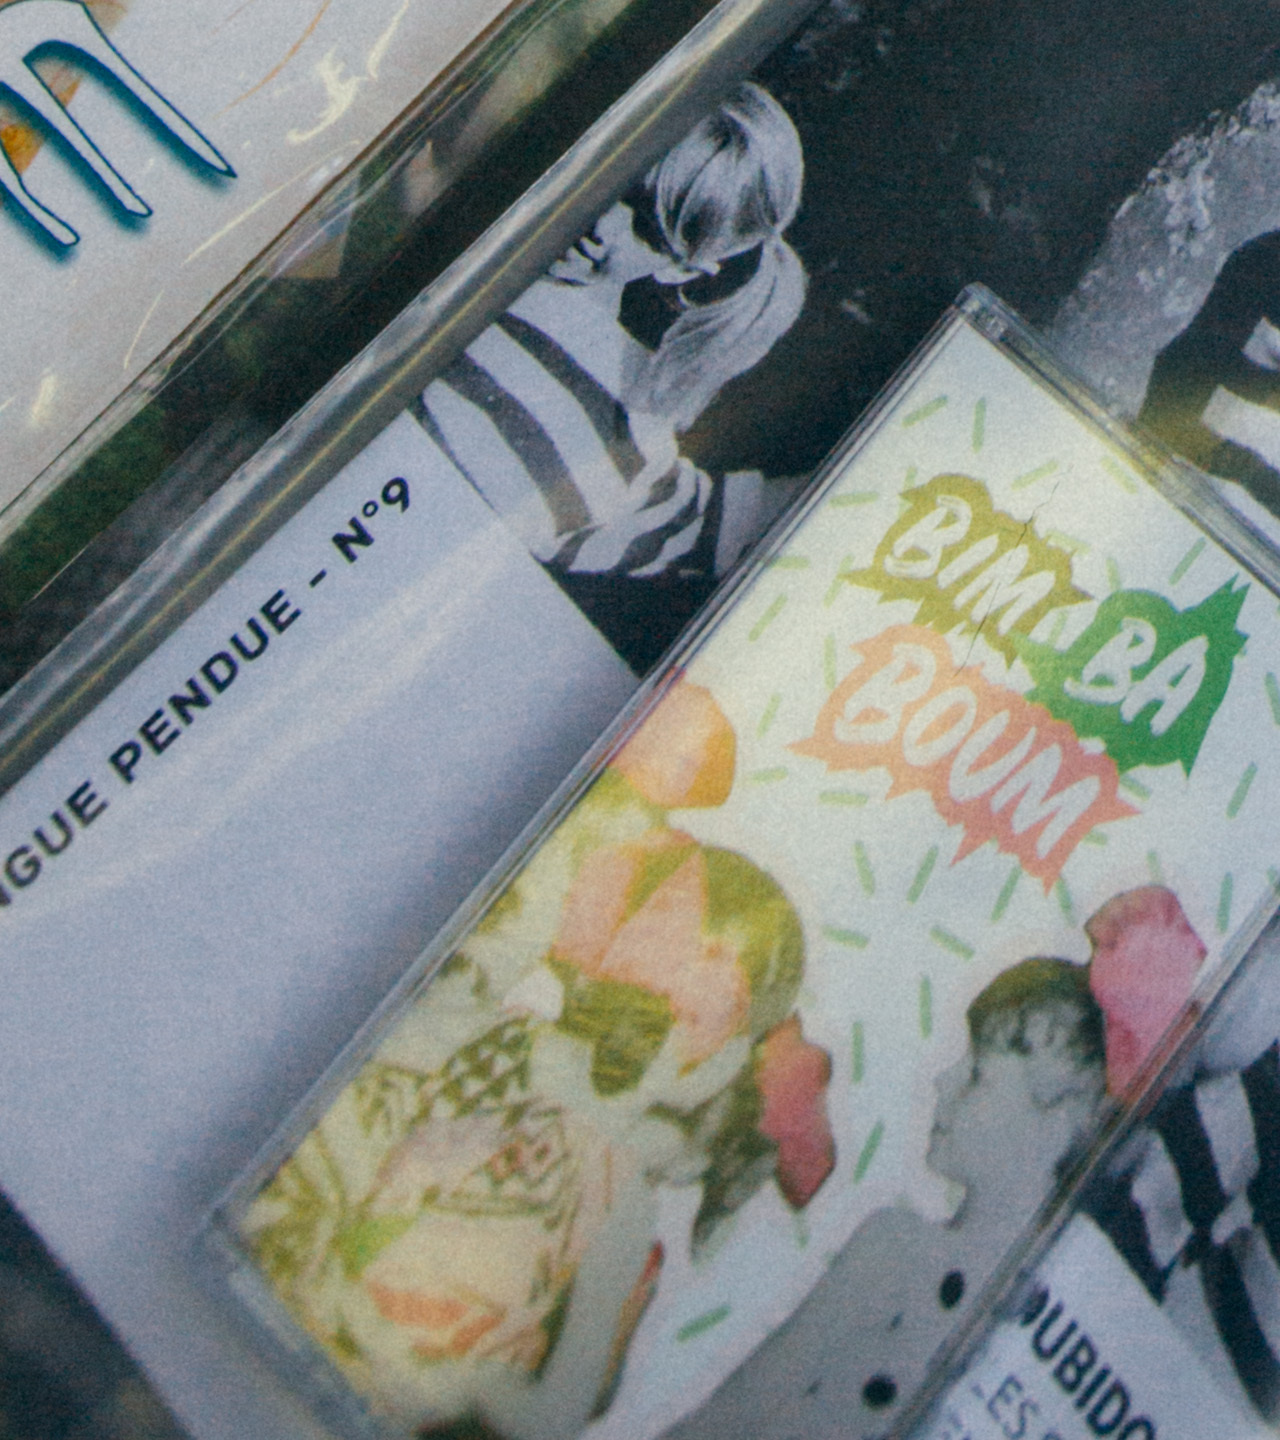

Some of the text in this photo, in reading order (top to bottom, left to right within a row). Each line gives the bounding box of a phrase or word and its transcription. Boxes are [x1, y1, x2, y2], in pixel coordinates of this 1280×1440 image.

[0, 779, 109, 908] GUE
[108, 588, 303, 784] PENDUE
[833, 642, 1101, 860] BOUM
